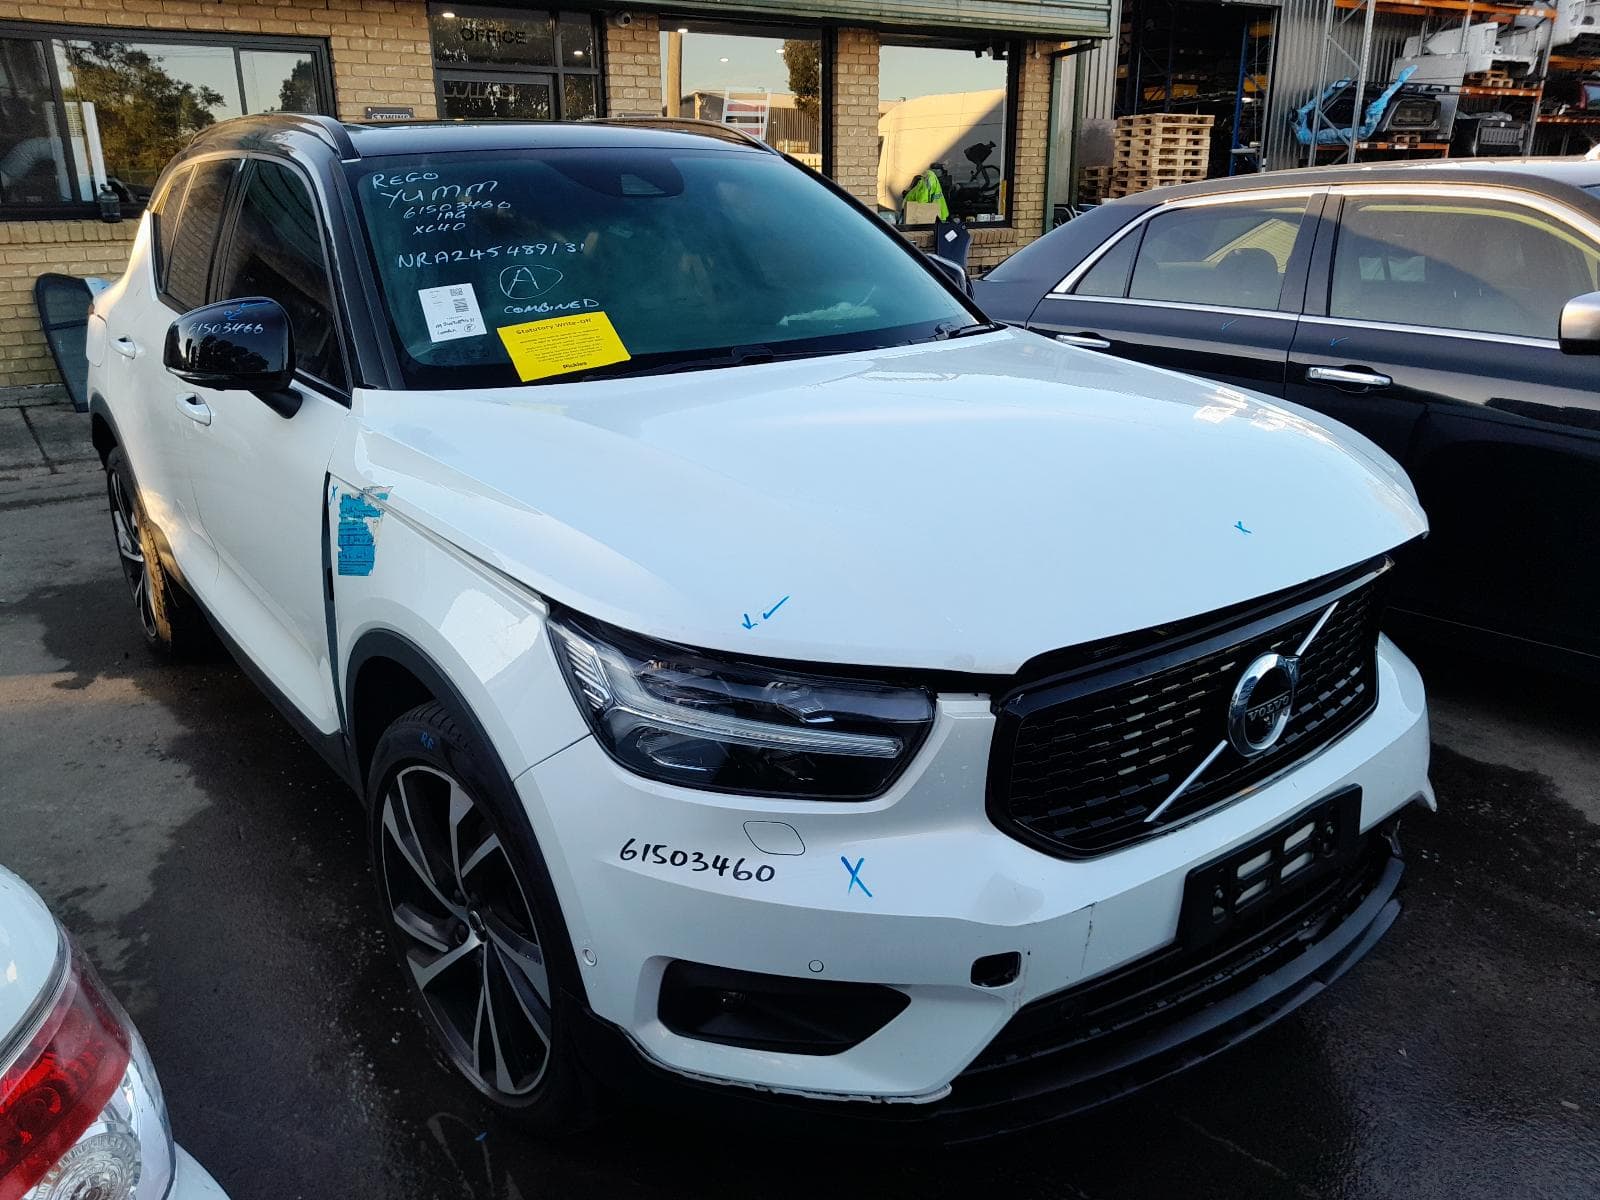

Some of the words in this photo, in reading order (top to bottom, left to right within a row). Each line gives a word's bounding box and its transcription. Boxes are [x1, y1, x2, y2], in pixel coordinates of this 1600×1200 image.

[460, 27, 527, 45] OFFICE
[372, 172, 439, 189] REGO
[403, 200, 512, 219] 61503460
[412, 222, 466, 236] XC40
[506, 266, 540, 296] A
[503, 298, 600, 314] COMBINED
[516, 322, 554, 335] Statutory
[555, 317, 592, 328] Write-Off
[562, 361, 588, 369] Pickles
[1247, 695, 1289, 720] VOLVO
[619, 838, 776, 882] 61503460
